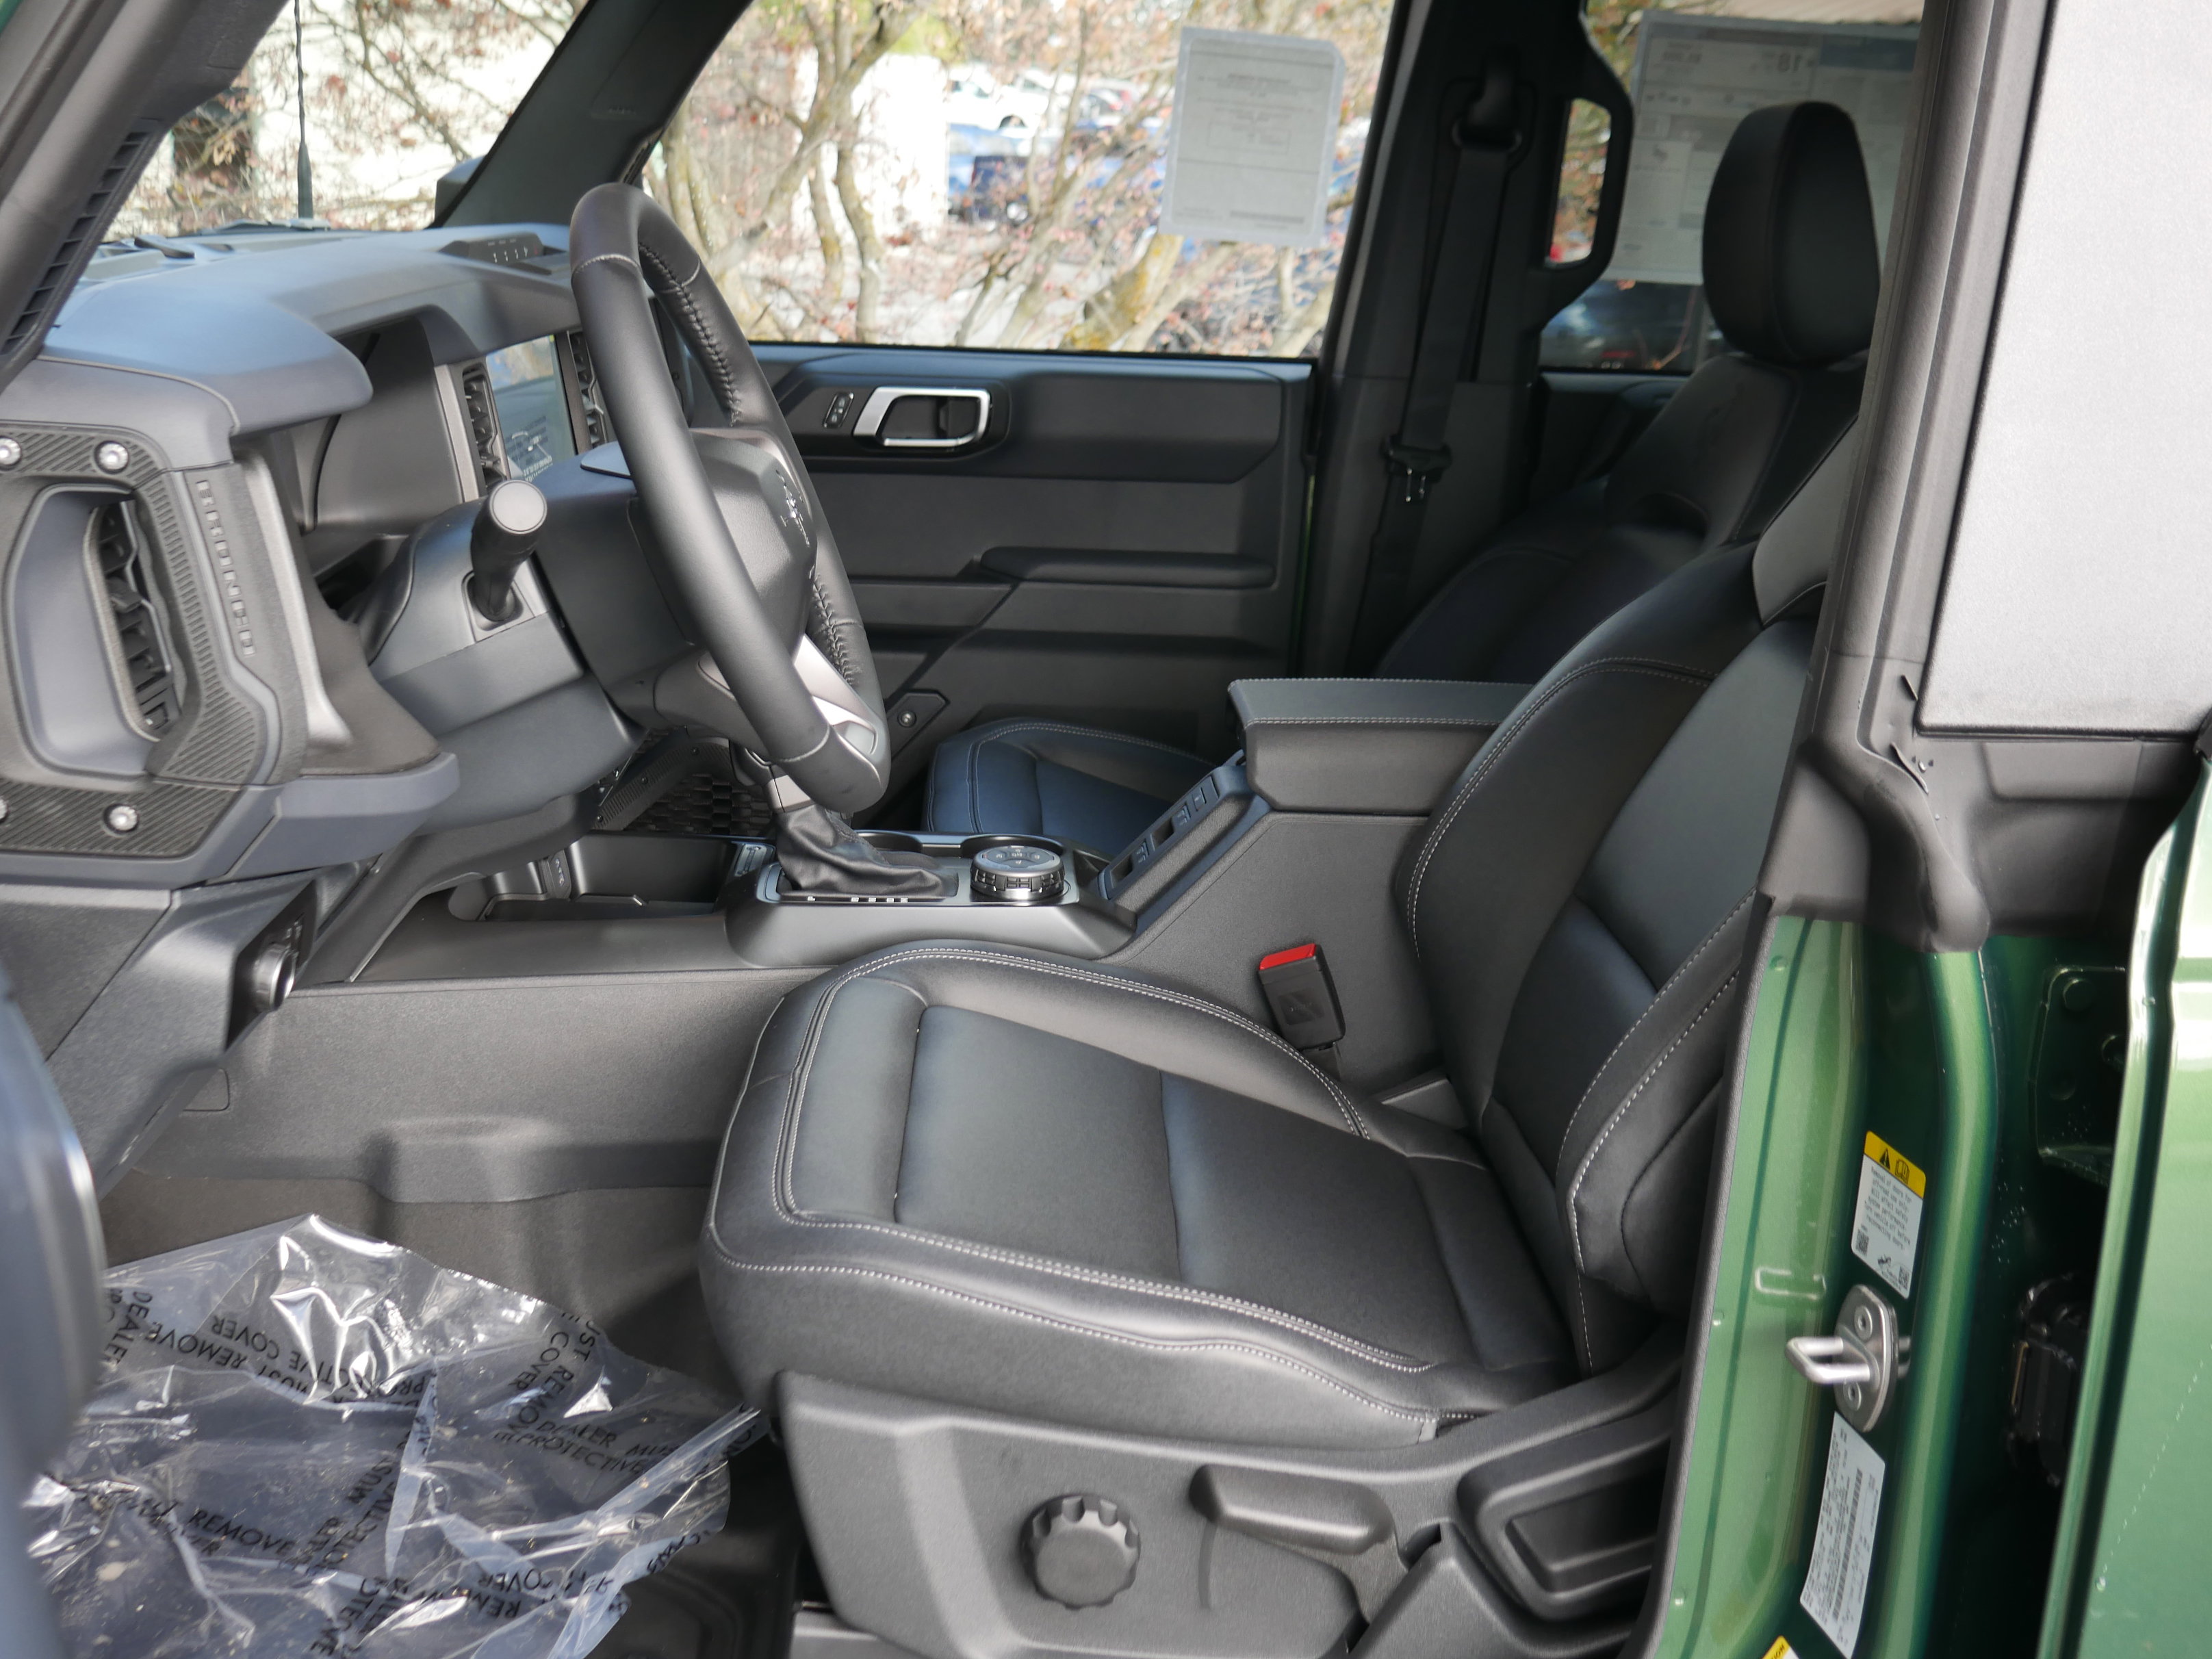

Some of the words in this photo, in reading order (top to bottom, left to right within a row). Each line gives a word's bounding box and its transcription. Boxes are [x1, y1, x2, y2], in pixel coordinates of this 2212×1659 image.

[196, 480, 256, 656] BRONCO
[101, 1290, 153, 1365] DEALE
[144, 1321, 248, 1369] REMOVE
[211, 1315, 279, 1360] COVER
[507, 1331, 569, 1391] COVER
[185, 1509, 296, 1556] REMOVE
